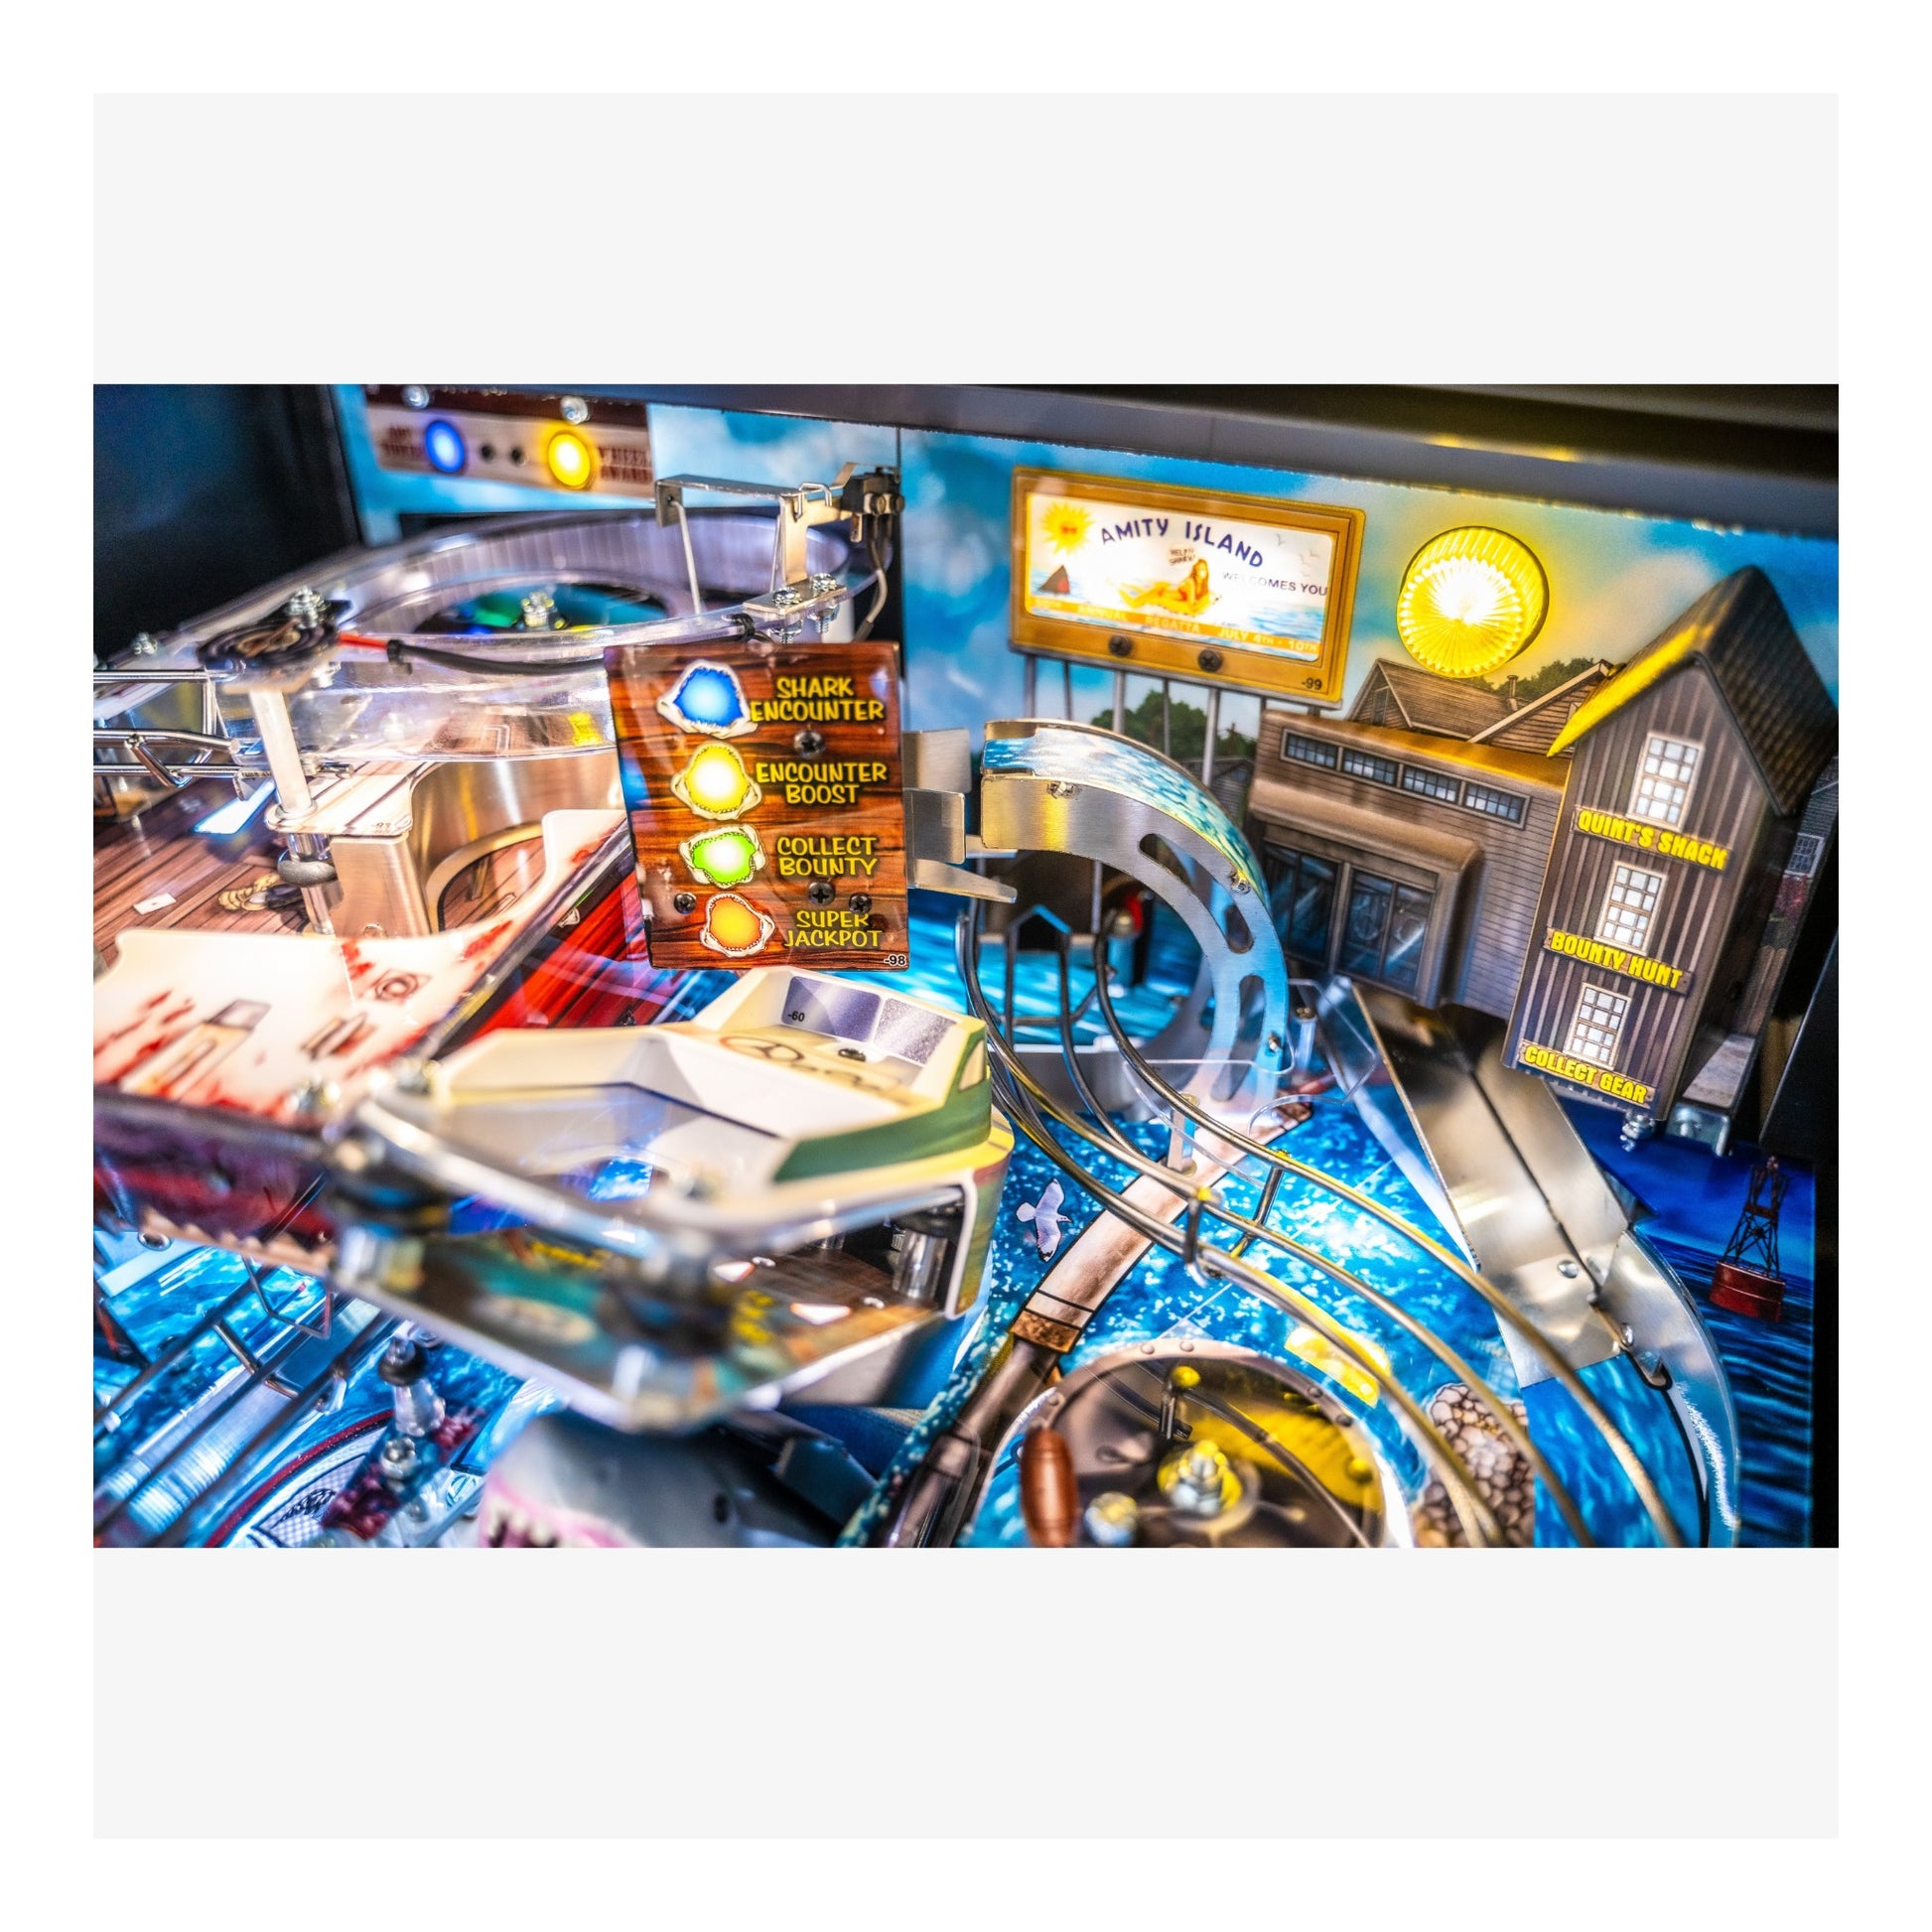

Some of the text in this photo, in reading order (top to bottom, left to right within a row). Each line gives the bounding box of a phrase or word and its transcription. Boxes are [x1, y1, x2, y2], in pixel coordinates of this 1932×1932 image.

[1100, 517, 1264, 569] AMITY ISLAND
[1301, 583, 1328, 597] YOU
[1144, 616, 1200, 633] REGATTA
[1218, 627, 1248, 641] JULY
[1253, 633, 1274, 644] 4TH
[1289, 640, 1317, 652] 10TH
[775, 676, 855, 699] SHARK
[1301, 677, 1323, 691] -99
[751, 699, 885, 723] ENCOUNTER
[756, 761, 888, 783] ENCOUNTER
[786, 783, 860, 805] BOOST
[776, 836, 877, 857] COLLECT
[1577, 810, 1728, 871] QUINT'S SHACK
[779, 857, 877, 878] BOUNTY
[795, 910, 870, 928] SUPER
[783, 929, 883, 948] JACKPOT
[885, 954, 906, 967] -98
[1549, 930, 1685, 989] BOUNTY HUNT
[787, 1010, 806, 1023] -60
[1524, 1043, 1648, 1104] COLLECT GEAR
